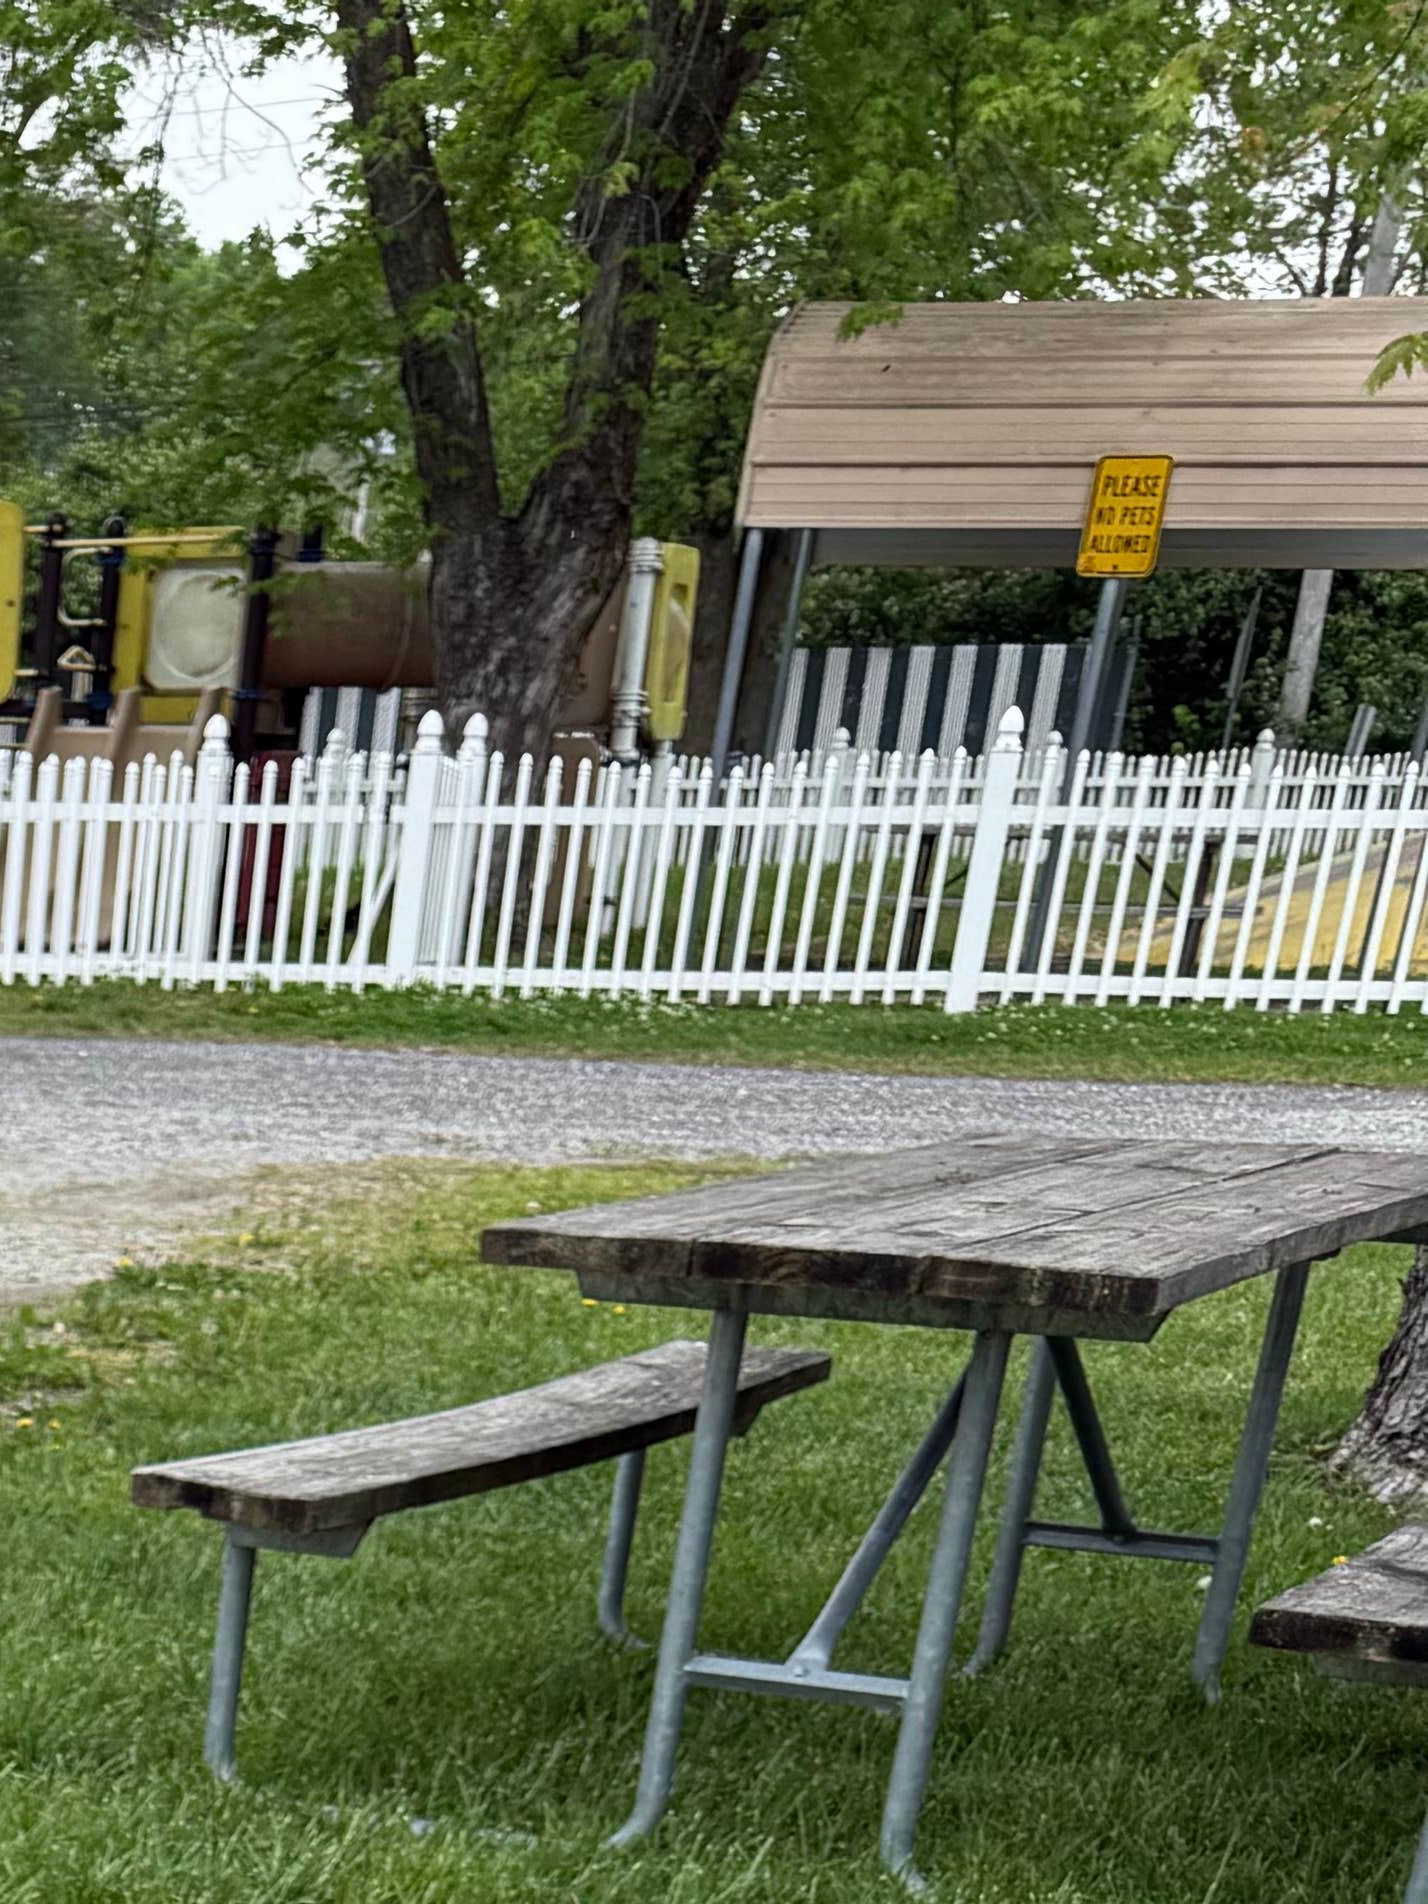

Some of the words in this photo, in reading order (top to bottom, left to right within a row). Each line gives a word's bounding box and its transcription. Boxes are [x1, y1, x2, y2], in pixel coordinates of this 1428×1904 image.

[1101, 475, 1162, 498] PLEASE
[1095, 506, 1115, 526] NO
[1119, 506, 1156, 526] PETS
[1091, 535, 1151, 554] ALLOWED
